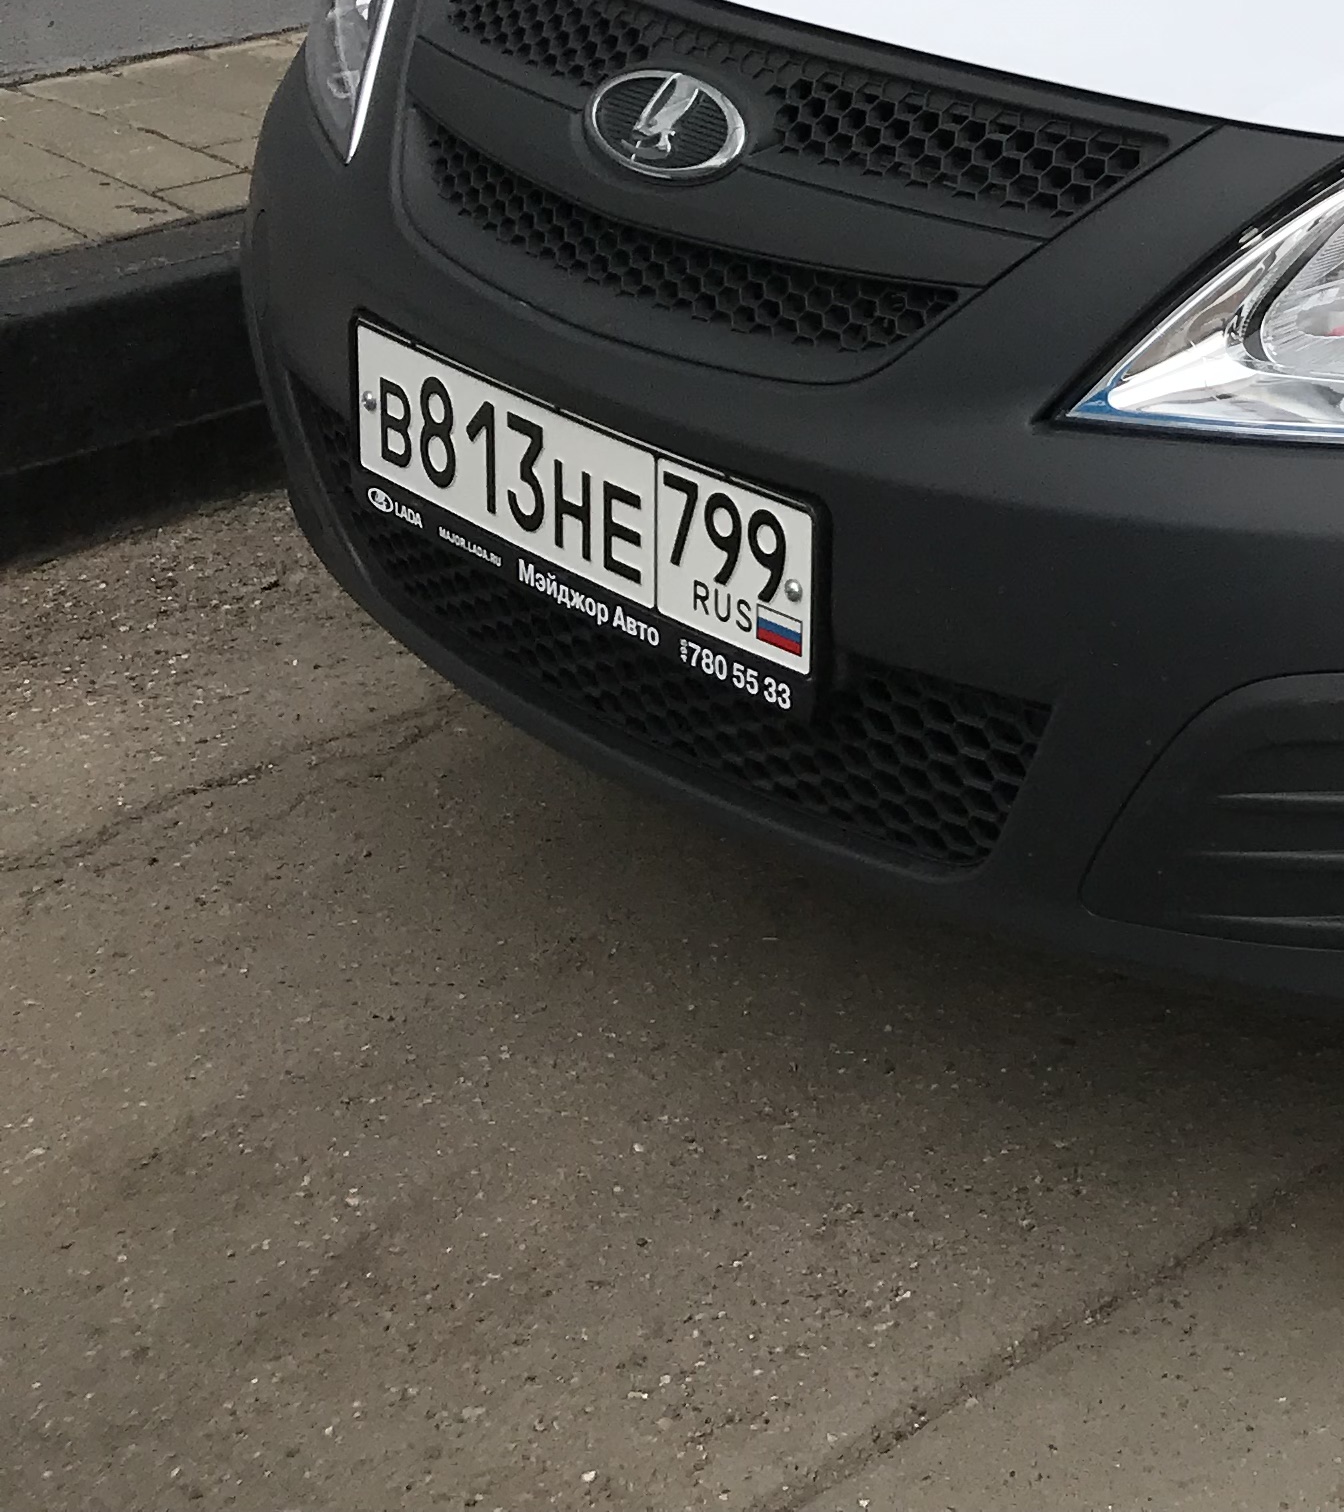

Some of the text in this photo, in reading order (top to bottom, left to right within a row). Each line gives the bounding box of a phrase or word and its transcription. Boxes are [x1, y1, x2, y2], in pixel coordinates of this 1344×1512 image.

[380, 376, 786, 602] В813НЕ 799
[395, 502, 423, 528] LADA
[518, 558, 660, 646] Мэйджор Авто
[693, 580, 752, 632] RUS
[688, 641, 728, 680] 780
[732, 662, 758, 695] 55
[763, 676, 791, 709] 33
